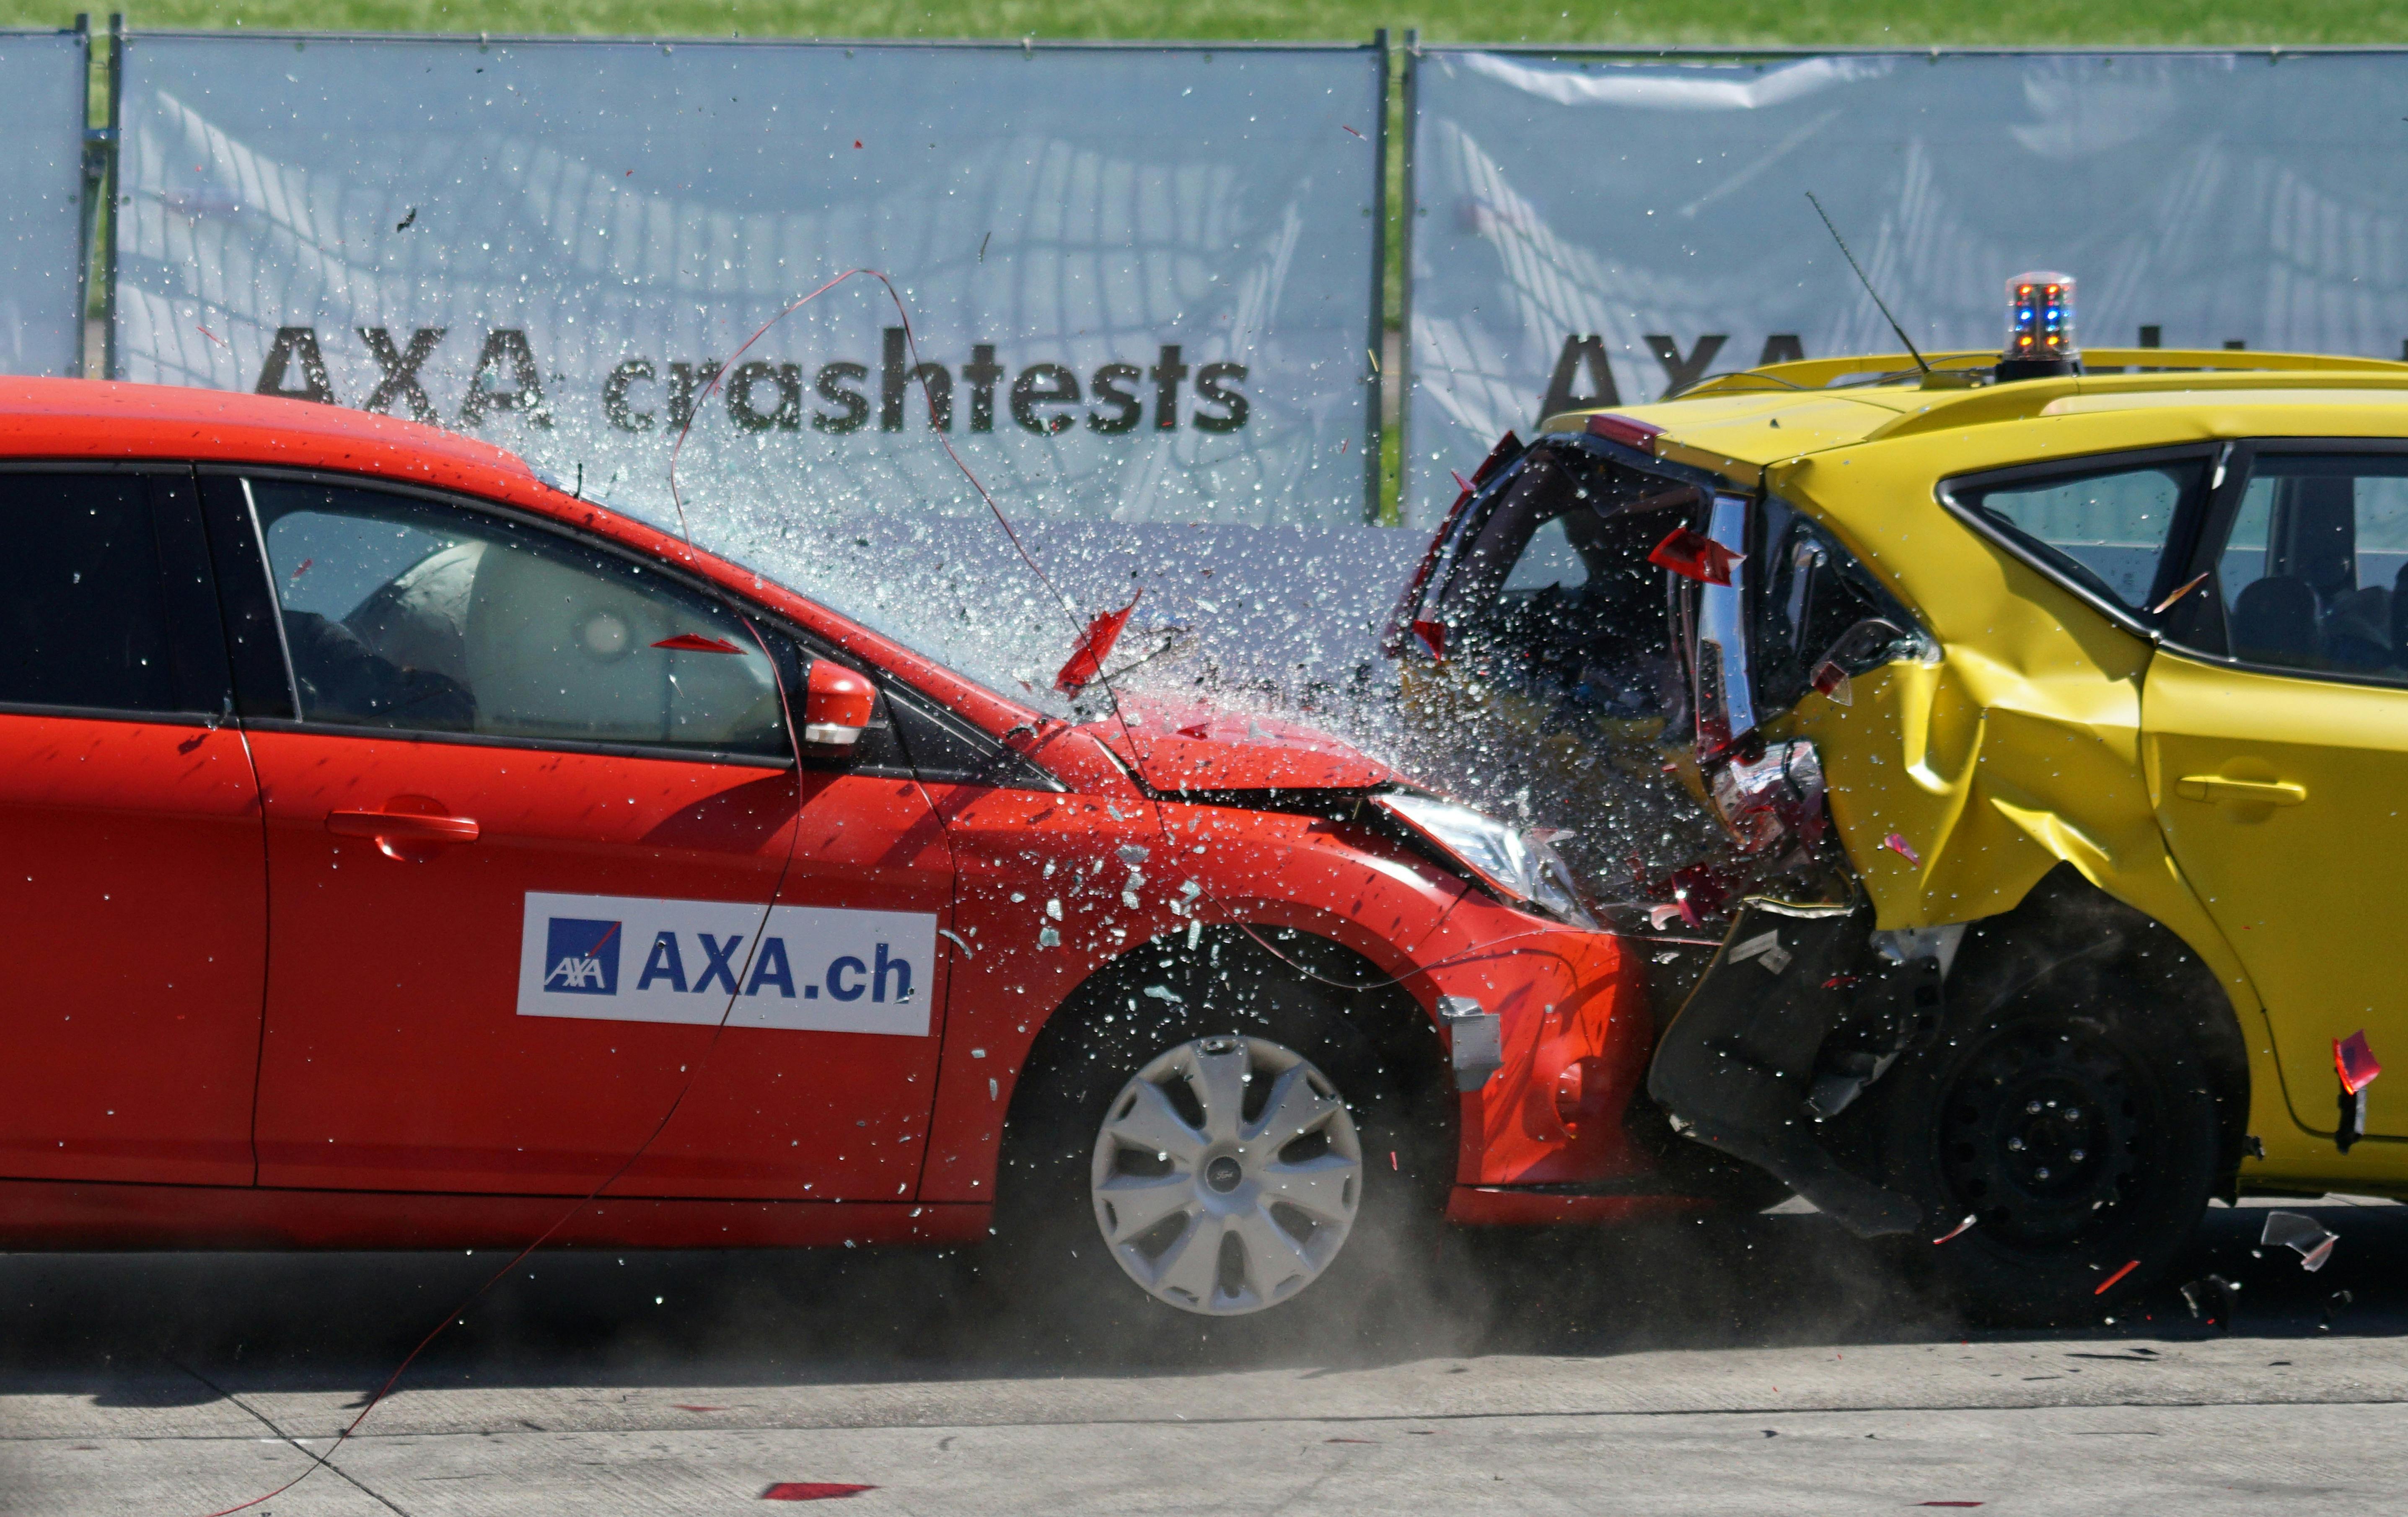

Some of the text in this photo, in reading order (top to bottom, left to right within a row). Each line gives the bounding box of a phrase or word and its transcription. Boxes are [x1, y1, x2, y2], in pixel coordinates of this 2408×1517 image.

[254, 327, 1250, 437] AXA crashtests
[544, 931, 913, 1004] AXA AXA.ch
